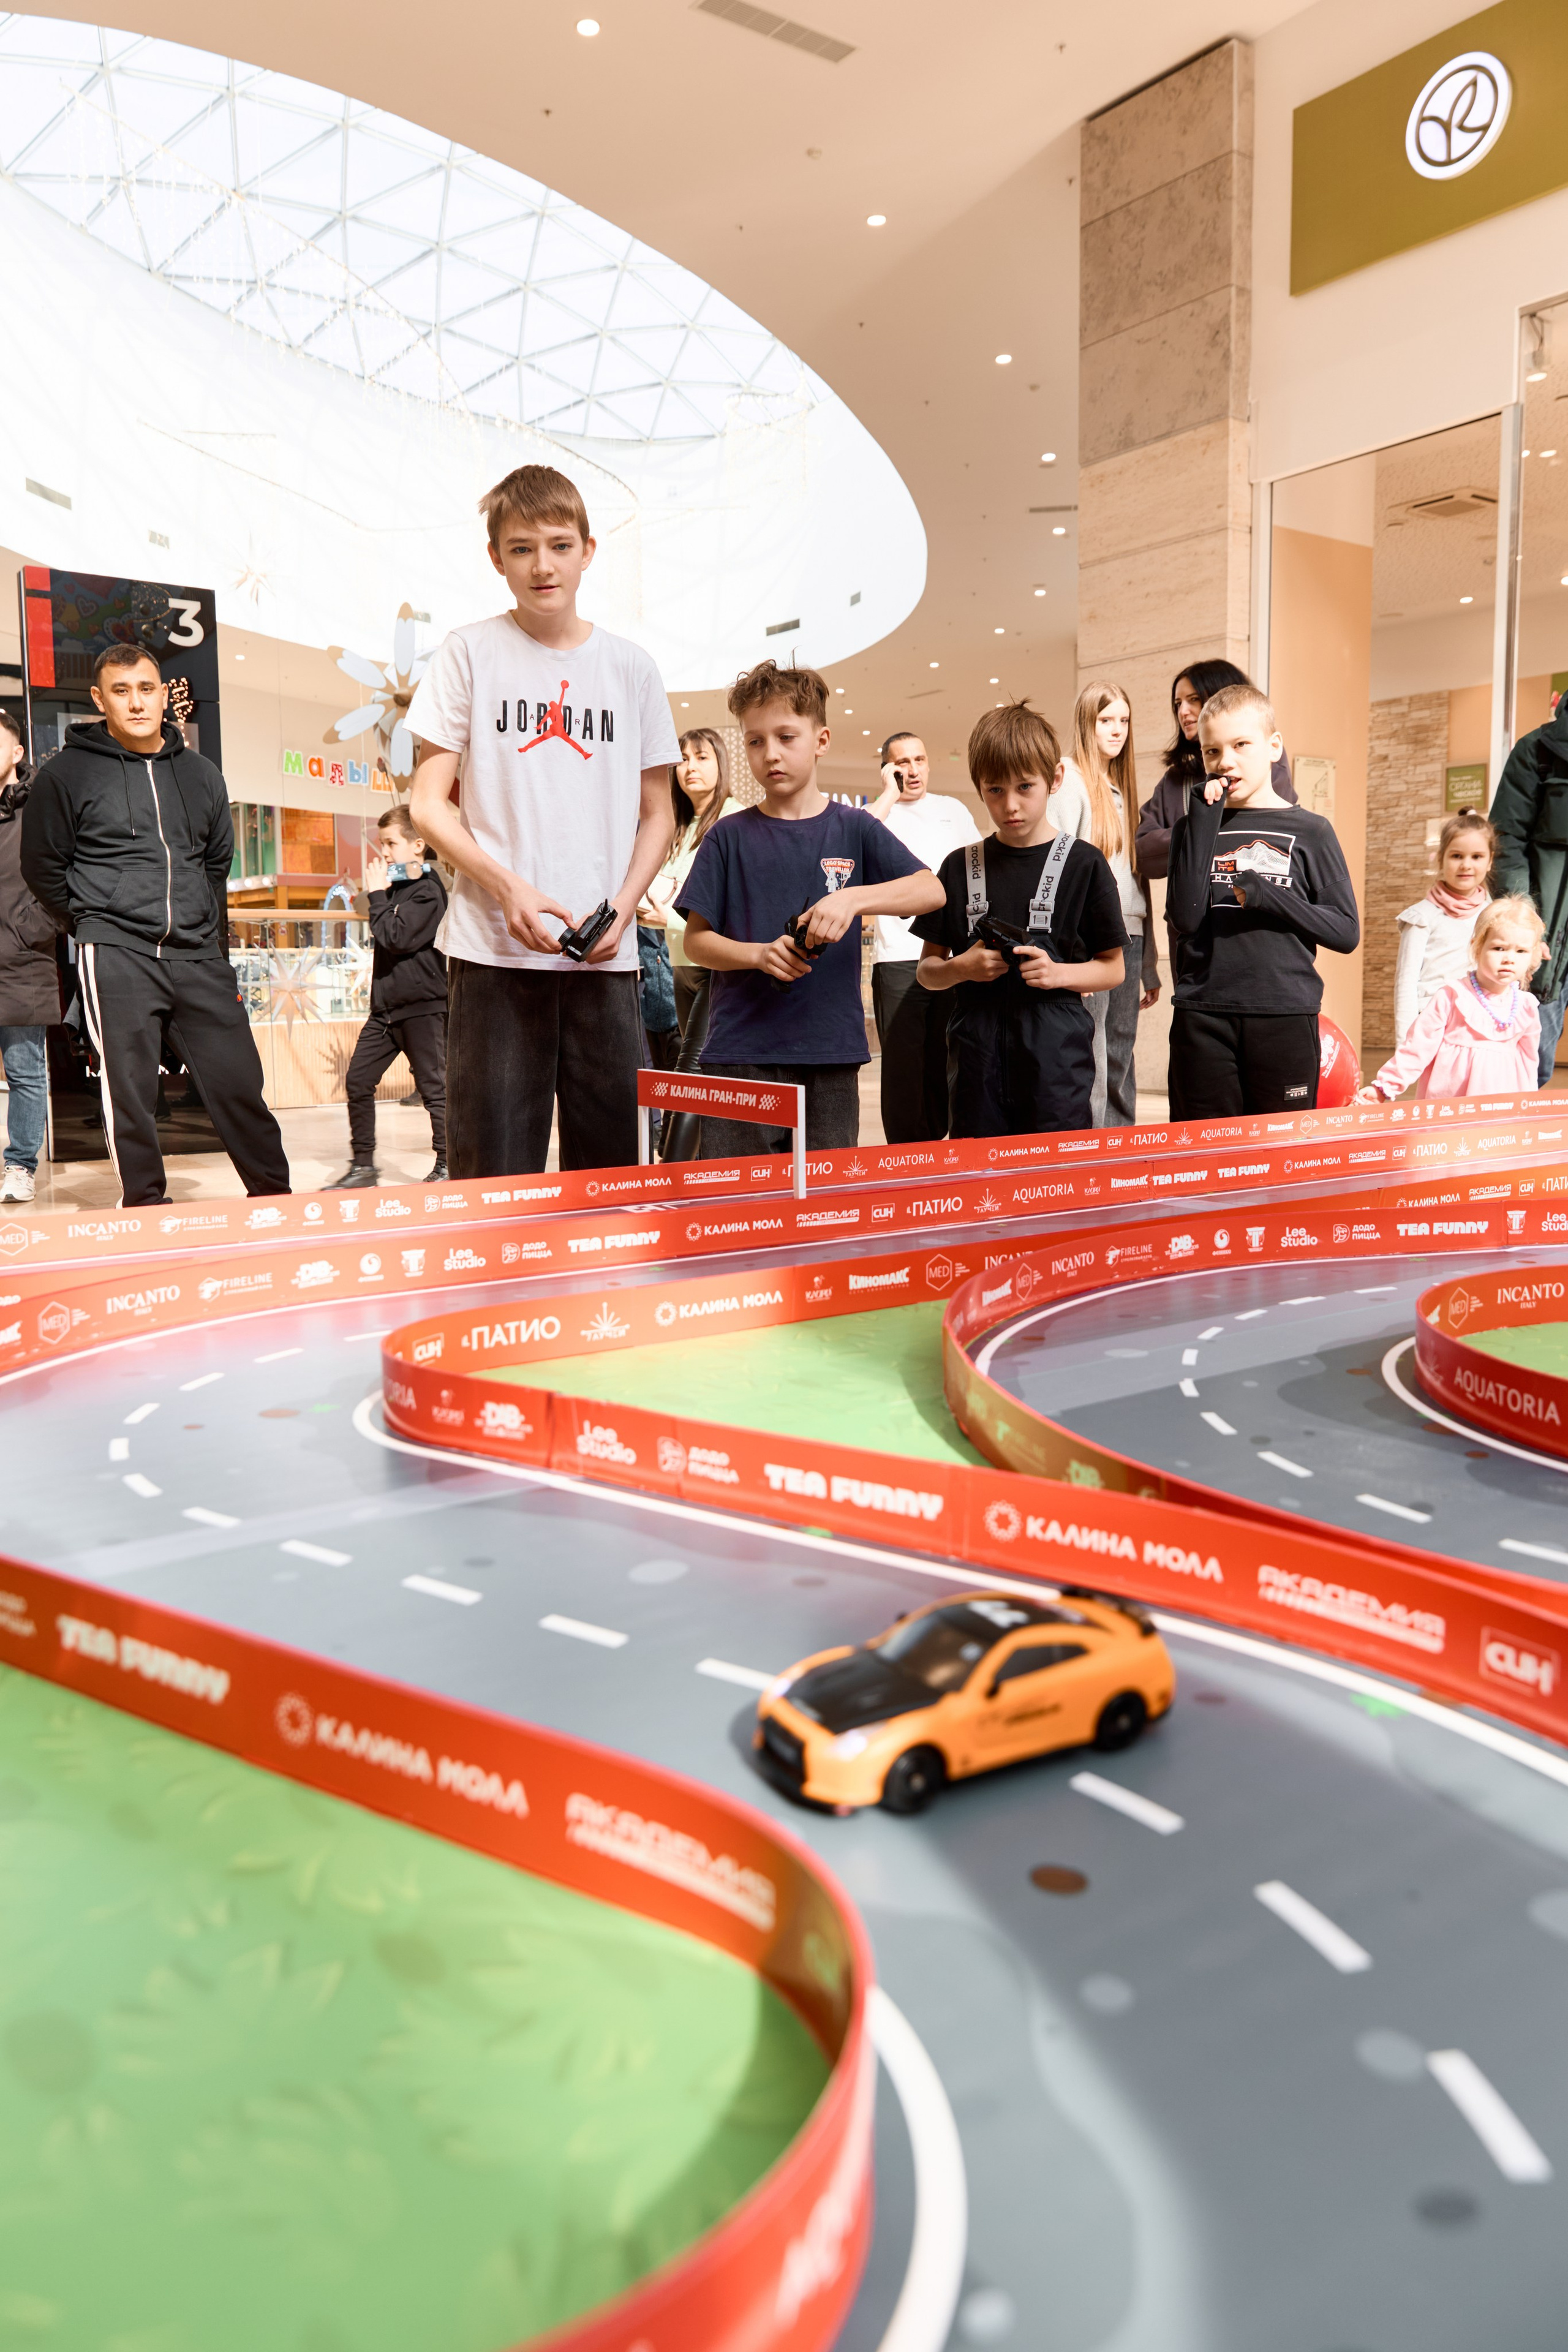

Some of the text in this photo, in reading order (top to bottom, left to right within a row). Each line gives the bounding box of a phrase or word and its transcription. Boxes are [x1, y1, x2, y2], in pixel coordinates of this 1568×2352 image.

[168, 597, 205, 647] 3
[496, 699, 614, 742] JORDAN
[971, 845, 981, 880] crockid
[670, 1085, 756, 1107] КАЛИНА ГРАН-ПРИ
[1326, 1114, 1353, 1125] INCANTO
[1134, 1132, 1167, 1145] ПАТИО
[1200, 1126, 1242, 1140] AQUATORIA
[1058, 1139, 1099, 1148] АКАДЕМИЯ
[1417, 1142, 1447, 1157] ПАТИО
[1478, 1135, 1516, 1150] AQUATORIA
[1000, 1145, 1050, 1158] КАЛИНА МОЛЛ
[1349, 1150, 1386, 1159] АКАДЕМИЯ
[878, 1153, 934, 1170] AQUATORIA
[1294, 1156, 1341, 1169] КАЛИНА МОЛЛ
[684, 1169, 741, 1180] АКАДЕМИЯ
[788, 1162, 833, 1177] ПТИО
[1218, 1164, 1270, 1178] TEA FUNNY
[602, 1177, 672, 1191] КАЛИНА МОЛЛ
[1111, 1174, 1148, 1188] КИНОМАКС
[1153, 1170, 1208, 1186] TEA FUNNY
[481, 1186, 562, 1204] TEA FUNNY
[1012, 1182, 1074, 1203] AQUATORIA
[1469, 1184, 1511, 1196] АКАДЕМИЯ
[380, 1199, 401, 1208] Lee
[913, 1196, 963, 1216] ПАТИО
[1409, 1193, 1460, 1208] КАЛИНА МОЛЛ
[375, 1206, 411, 1218] Studio
[796, 1208, 860, 1222] АКАДЕМИЯ
[1547, 1212, 1566, 1222] Lee
[184, 1215, 228, 1226] FIRELINE
[704, 1218, 783, 1235] КАЛИНА МОЛЛ
[68, 1219, 141, 1238] INCANTO
[1286, 1227, 1306, 1237] Lee
[1396, 1221, 1488, 1236] TEA FUNNY
[0, 1232, 25, 1245] MED
[568, 1231, 660, 1253] TEA FUNNY
[1281, 1235, 1317, 1247] Studio
[450, 1248, 473, 1259] Lee
[1120, 1243, 1153, 1256] FIRELINE
[443, 1255, 486, 1271] Studio
[1052, 1251, 1095, 1275] INCANTO
[849, 1267, 910, 1291] КИНОМАКС
[929, 1265, 949, 1278] MED
[223, 1272, 273, 1288] FIRELINE
[106, 1285, 181, 1314] INCANTO
[1496, 1282, 1565, 1304] INCANTO
[680, 1291, 783, 1319] КАЛИНА МОЛЛ
[1520, 1301, 1536, 1310] ITALY
[471, 1316, 560, 1351] ПАТИО
[1453, 1366, 1561, 1426] AQUATORIA
[584, 1420, 617, 1443] Lee
[764, 1463, 827, 1499] TEA
[1026, 1515, 1224, 1584] КАЛИНА МОЛЛ
[315, 1713, 433, 1784] КАЛИНА
